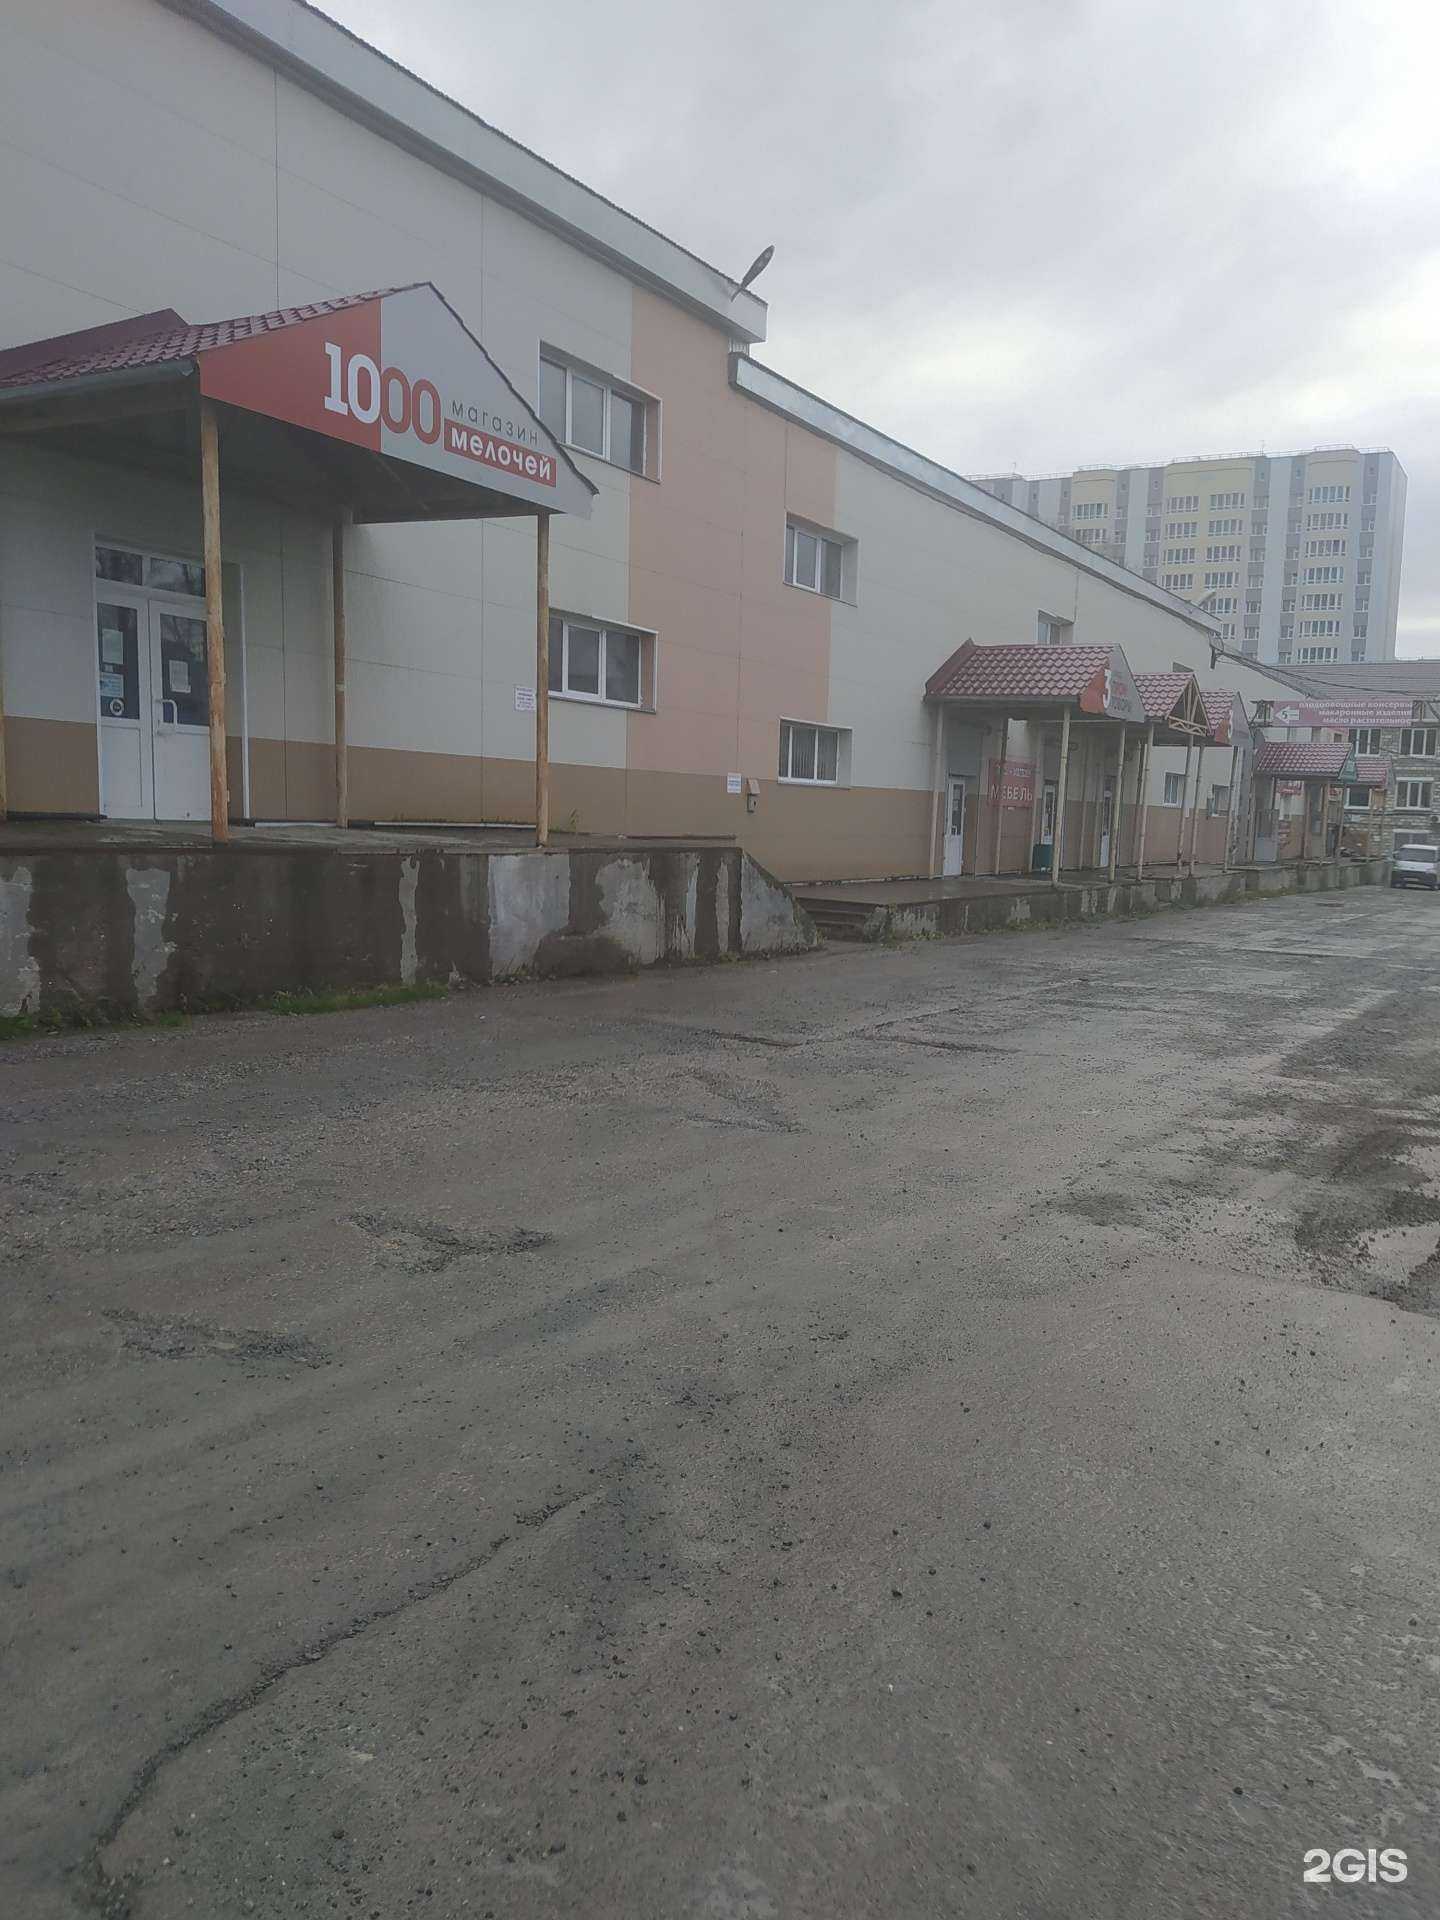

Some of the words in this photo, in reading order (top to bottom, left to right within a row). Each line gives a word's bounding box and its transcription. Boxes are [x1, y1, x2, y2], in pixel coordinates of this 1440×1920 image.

[323, 341, 442, 445] 1000
[452, 399, 538, 445] магазин
[451, 427, 551, 480] мелочей
